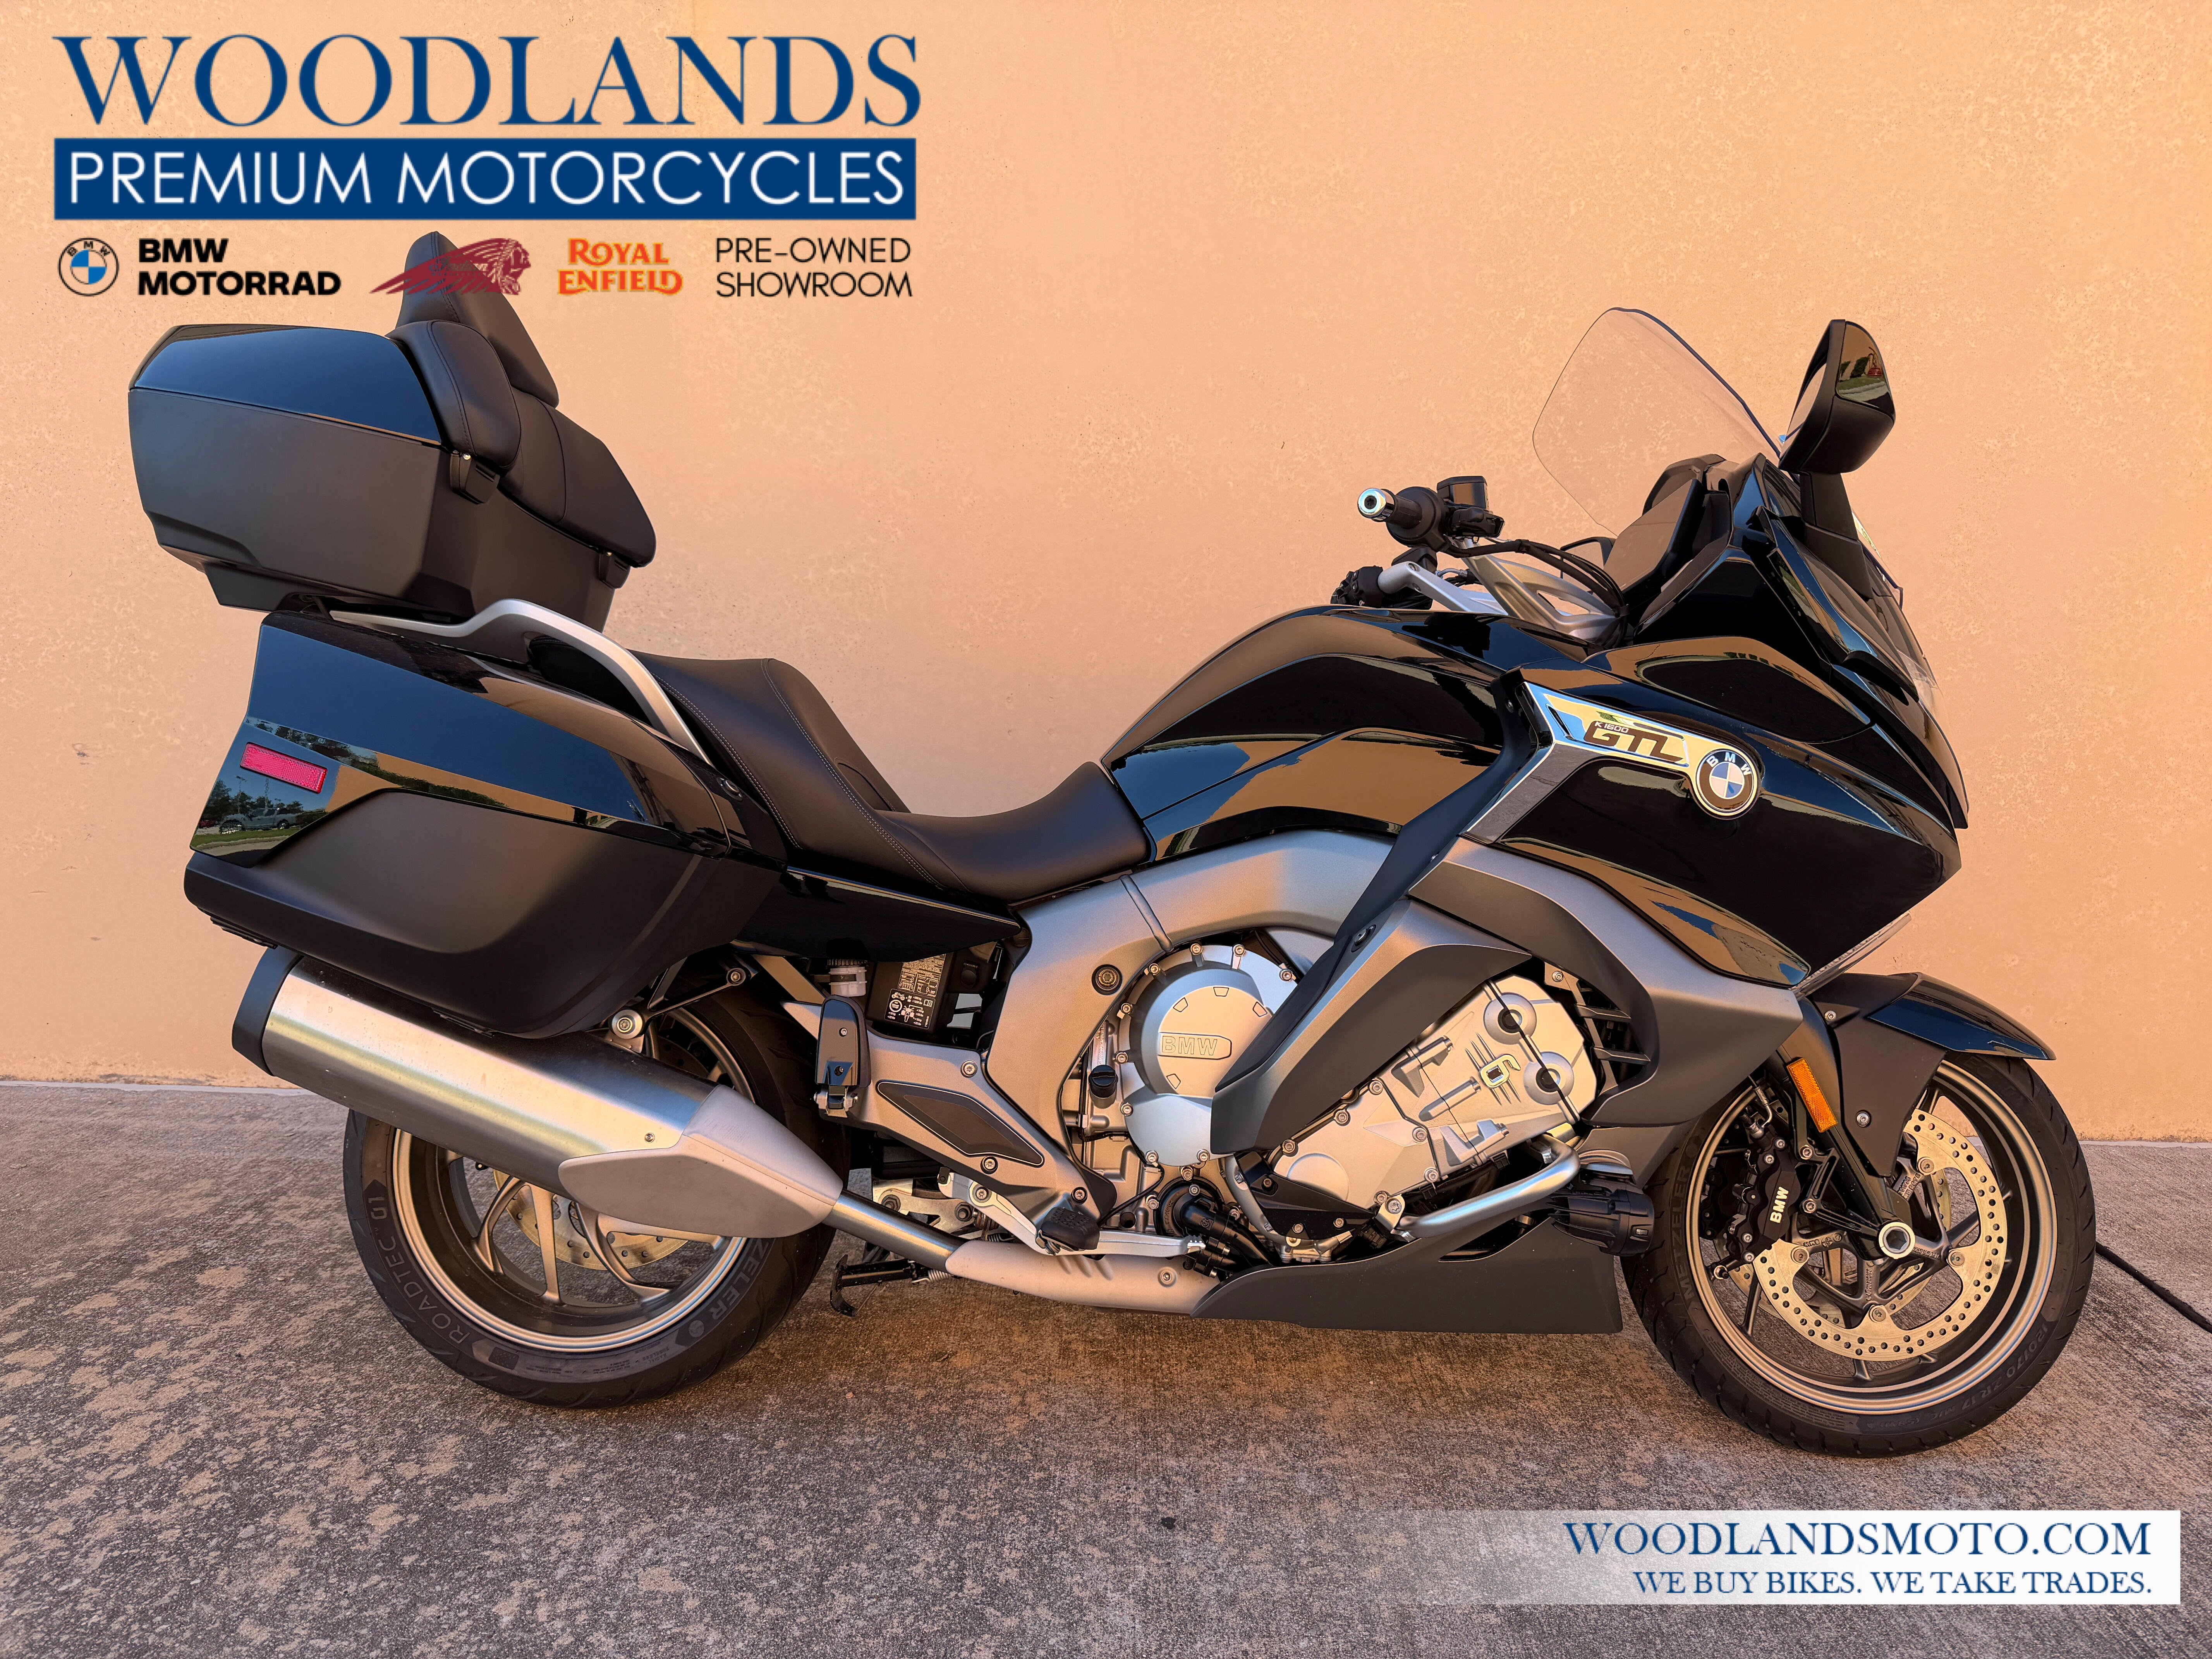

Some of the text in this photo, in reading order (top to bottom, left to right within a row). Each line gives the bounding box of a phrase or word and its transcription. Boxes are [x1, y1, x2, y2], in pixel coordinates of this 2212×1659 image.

[1604, 723, 1629, 733] 1600
[1583, 720, 1684, 762] GTL
[1706, 752, 1751, 776] BMW
[1162, 1035, 1218, 1056] BMW
[368, 1196, 388, 1220] 01
[1769, 1186, 1789, 1223] BMW
[1671, 1164, 1695, 1301] METZELER
[708, 1238, 770, 1320] ZELER
[1961, 1397, 1977, 1411] 17
